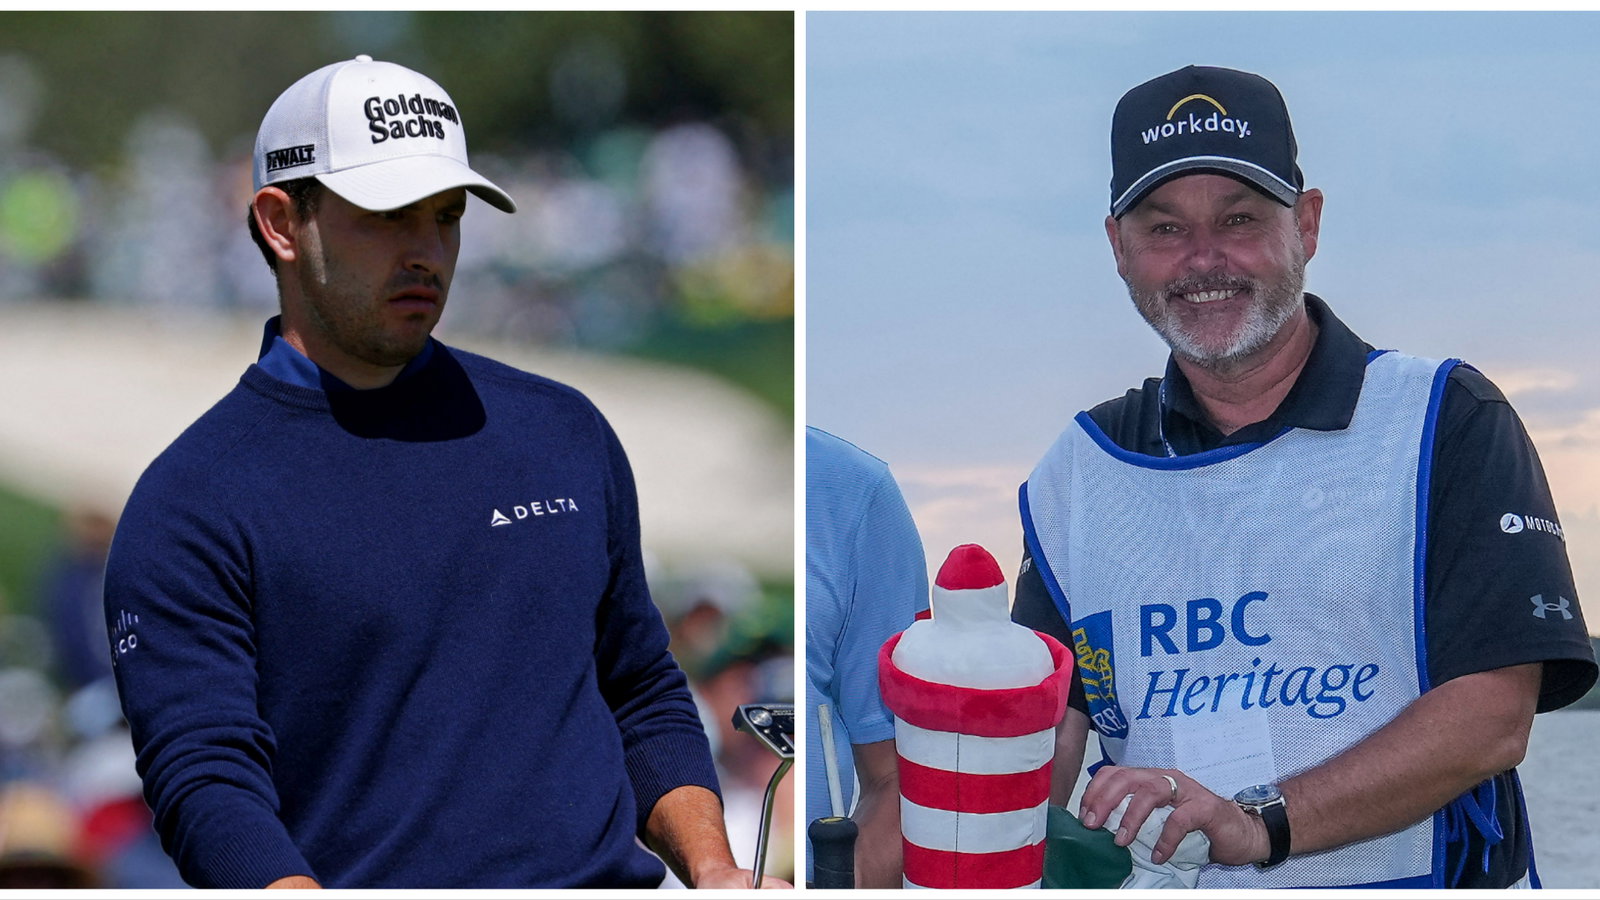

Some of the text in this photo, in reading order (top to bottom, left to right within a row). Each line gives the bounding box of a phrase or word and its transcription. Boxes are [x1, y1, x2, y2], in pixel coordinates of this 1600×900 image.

[363, 94, 459, 125] Goldman
[368, 116, 445, 144] Sachs
[513, 498, 579, 520] DELTA
[1139, 591, 1273, 657] RBC
[1135, 657, 1380, 720] Heritage
